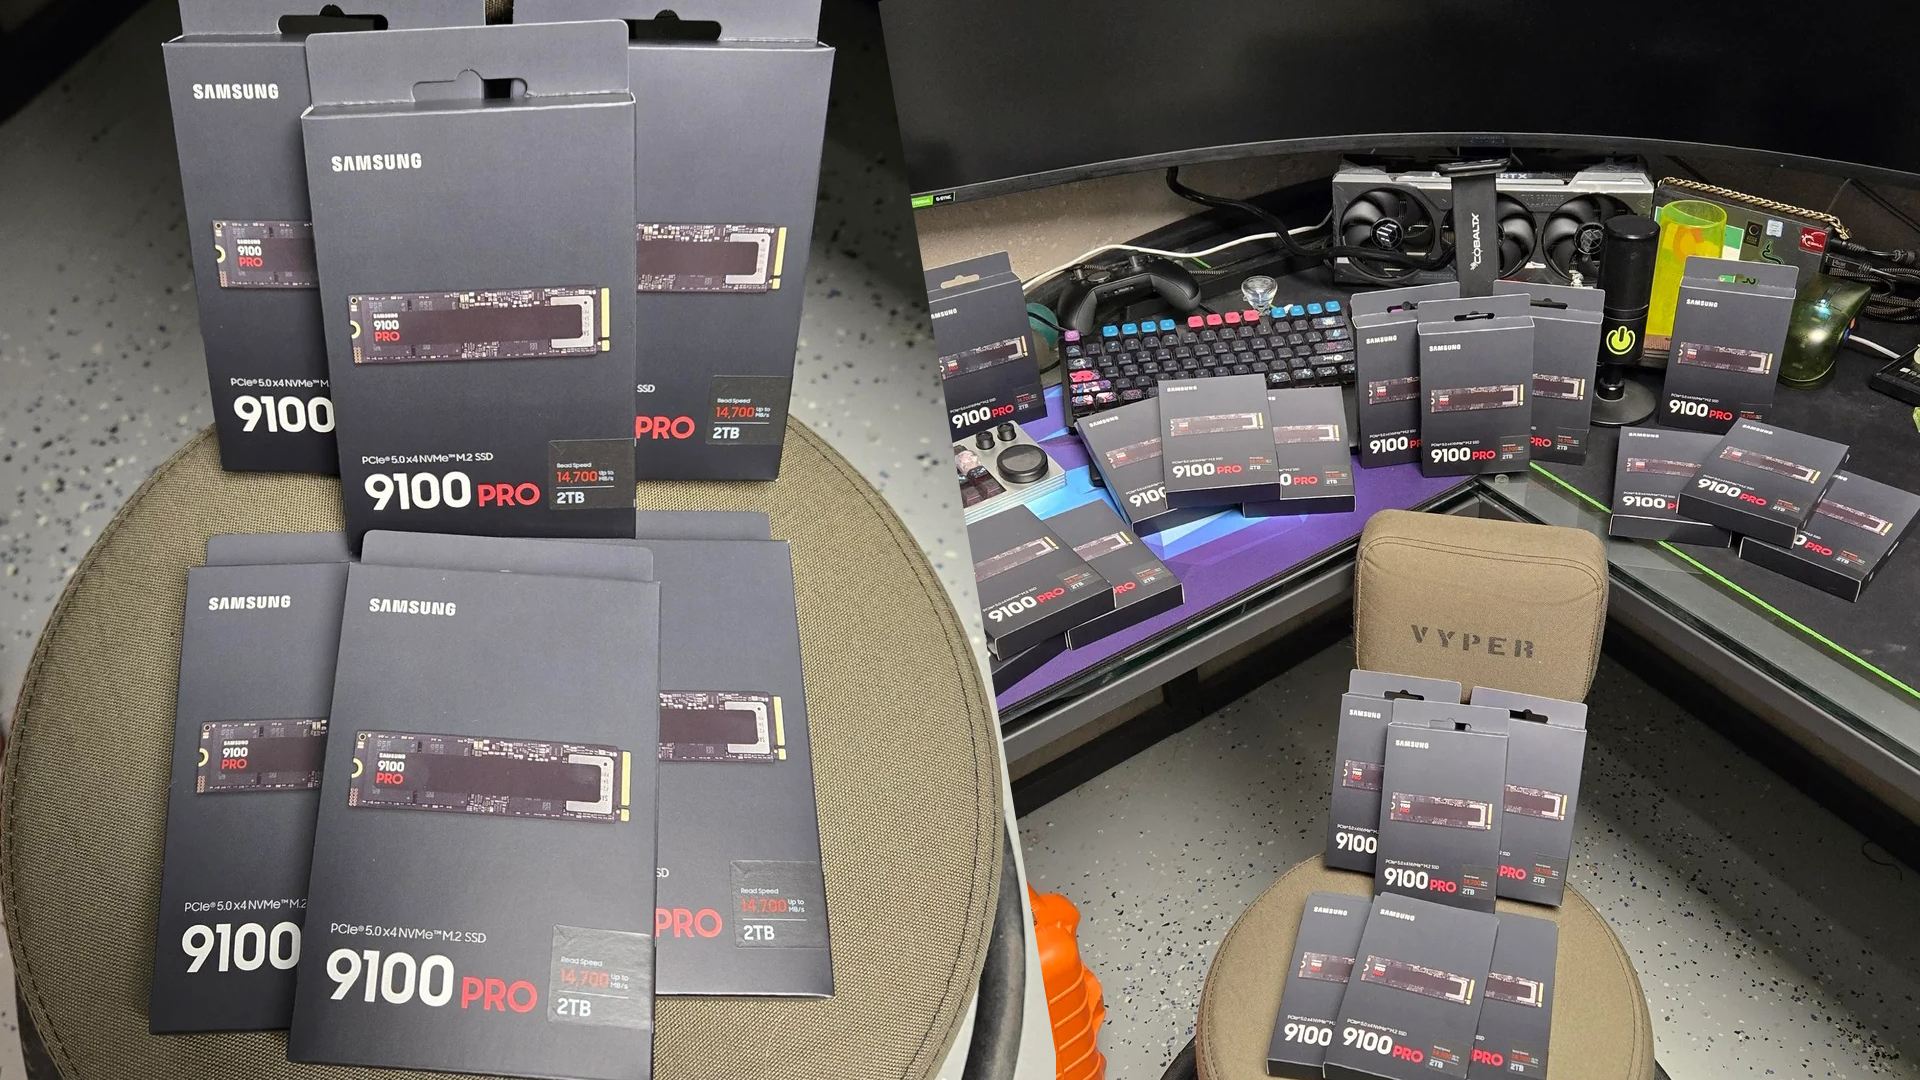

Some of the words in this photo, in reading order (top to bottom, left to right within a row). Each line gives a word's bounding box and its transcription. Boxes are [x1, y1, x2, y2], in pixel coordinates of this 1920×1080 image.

[193, 83, 279, 99] SAMSUNG
[331, 152, 422, 172] SAMSUNG
[1471, 212, 1482, 265] COBALTX
[237, 245, 262, 256] 9100
[238, 256, 263, 268] PRO
[1686, 299, 1718, 308] SAMSUNG
[931, 308, 957, 320] AMSUNG
[373, 320, 400, 330] 9100
[374, 331, 400, 341] PRO
[1366, 335, 1397, 344] SAMSUNG
[1428, 344, 1461, 352] SAMSUNG
[258, 379, 271, 387] 5.0
[636, 384, 656, 393] SSD
[233, 395, 335, 433] 9100
[715, 406, 755, 419] 14,700
[952, 406, 991, 429] 9100
[991, 404, 1015, 418] PRO
[1669, 400, 1709, 417] 9100
[1709, 410, 1733, 421] PRO
[635, 416, 696, 440] PRO
[1089, 416, 1119, 428] SAMSUNG
[712, 427, 740, 439] 2TB
[1742, 424, 1774, 435] SAMSUNG
[1369, 436, 1409, 454] 9100
[391, 455, 405, 464] 5.0
[456, 453, 473, 462] M.2
[475, 452, 494, 461] SSD
[1431, 447, 1471, 463] 9100
[1472, 450, 1496, 460] PRO
[556, 471, 598, 483] 14,700
[1172, 463, 1215, 478] 9100
[1217, 464, 1242, 474] PRO
[1293, 475, 1318, 486] PRO
[364, 471, 472, 511] 9100
[477, 482, 541, 508] PRO
[556, 491, 585, 504] 2TB
[1697, 478, 1742, 498] 9100
[1740, 493, 1767, 506] PRO
[1622, 496, 1666, 509] 9100
[1804, 541, 1833, 556] PRO
[208, 595, 291, 611] SAMSUNG
[369, 598, 456, 616] SAMSUNG
[988, 596, 1037, 623] 9100
[1036, 587, 1065, 604] PRO
[1411, 624, 1534, 659] VYPER
[1349, 709, 1381, 719] SAMSUNG
[1395, 739, 1429, 749] SAMSUNG
[222, 747, 248, 758] 9100
[221, 759, 247, 769] PRO
[377, 761, 405, 772] 9100
[375, 772, 404, 785] PRO
[1335, 831, 1377, 854] 9100
[1500, 865, 1527, 880] PRO
[1384, 867, 1429, 890] 9100
[1430, 879, 1457, 893] PRO
[1533, 876, 1546, 884] 2TB
[217, 901, 232, 911] 5.0
[233, 901, 247, 910] x4
[1313, 906, 1348, 916] SAMSUNG
[1380, 908, 1415, 921] SAMSUNG
[656, 908, 723, 938] PRO
[365, 925, 382, 936] 5.0
[382, 926, 397, 937] x4
[442, 930, 462, 942] M.2
[464, 932, 487, 943] SSD
[743, 925, 775, 941] 2TB
[182, 921, 301, 973] 9100
[326, 948, 455, 1007] 9100
[460, 976, 538, 1013] PRO
[556, 997, 591, 1017] 2TB
[1284, 1023, 1333, 1046] 9100
[1343, 1027, 1393, 1055] 9100
[1392, 1045, 1424, 1063] PRO
[1429, 1058, 1443, 1069] 2TB
[1472, 1049, 1504, 1067] PRO
[1510, 1063, 1524, 1072] 2TB
